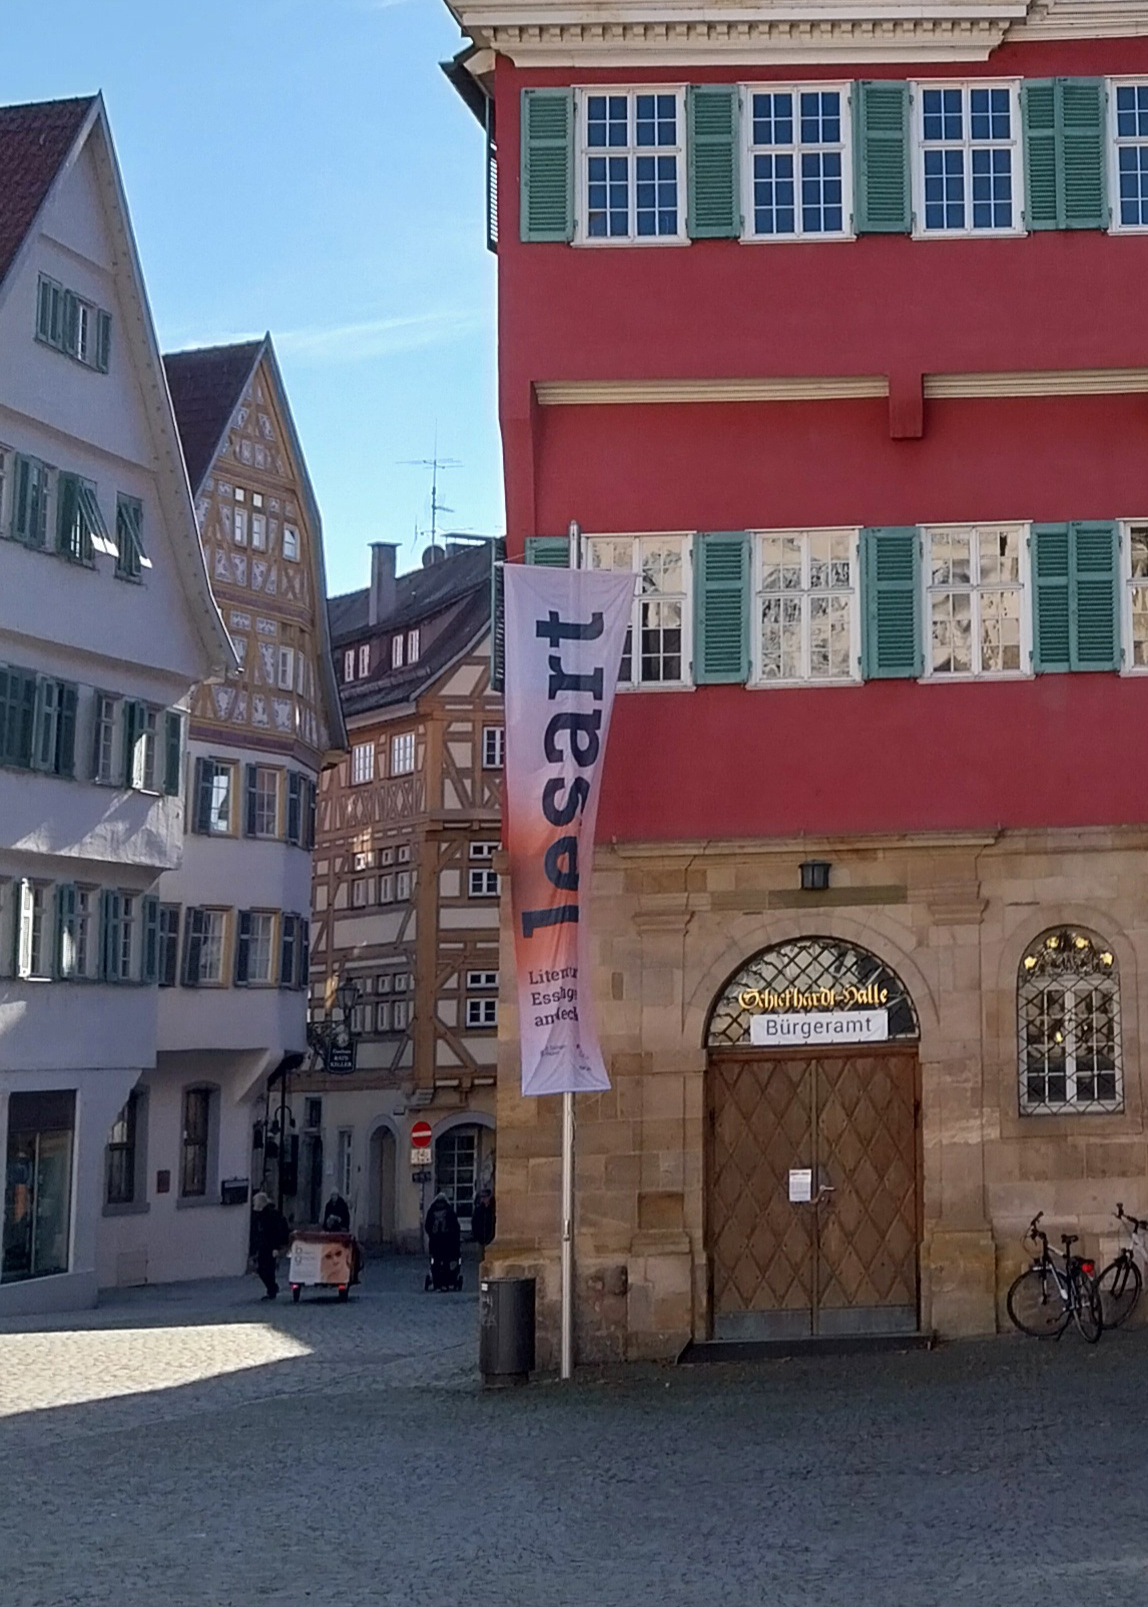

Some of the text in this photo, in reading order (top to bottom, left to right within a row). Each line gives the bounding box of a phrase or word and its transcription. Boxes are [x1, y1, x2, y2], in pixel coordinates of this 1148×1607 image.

[522, 610, 604, 938] lesart
[739, 982, 889, 1011] Schickhardt-Halle
[766, 1017, 873, 1039] Bürgeramt
